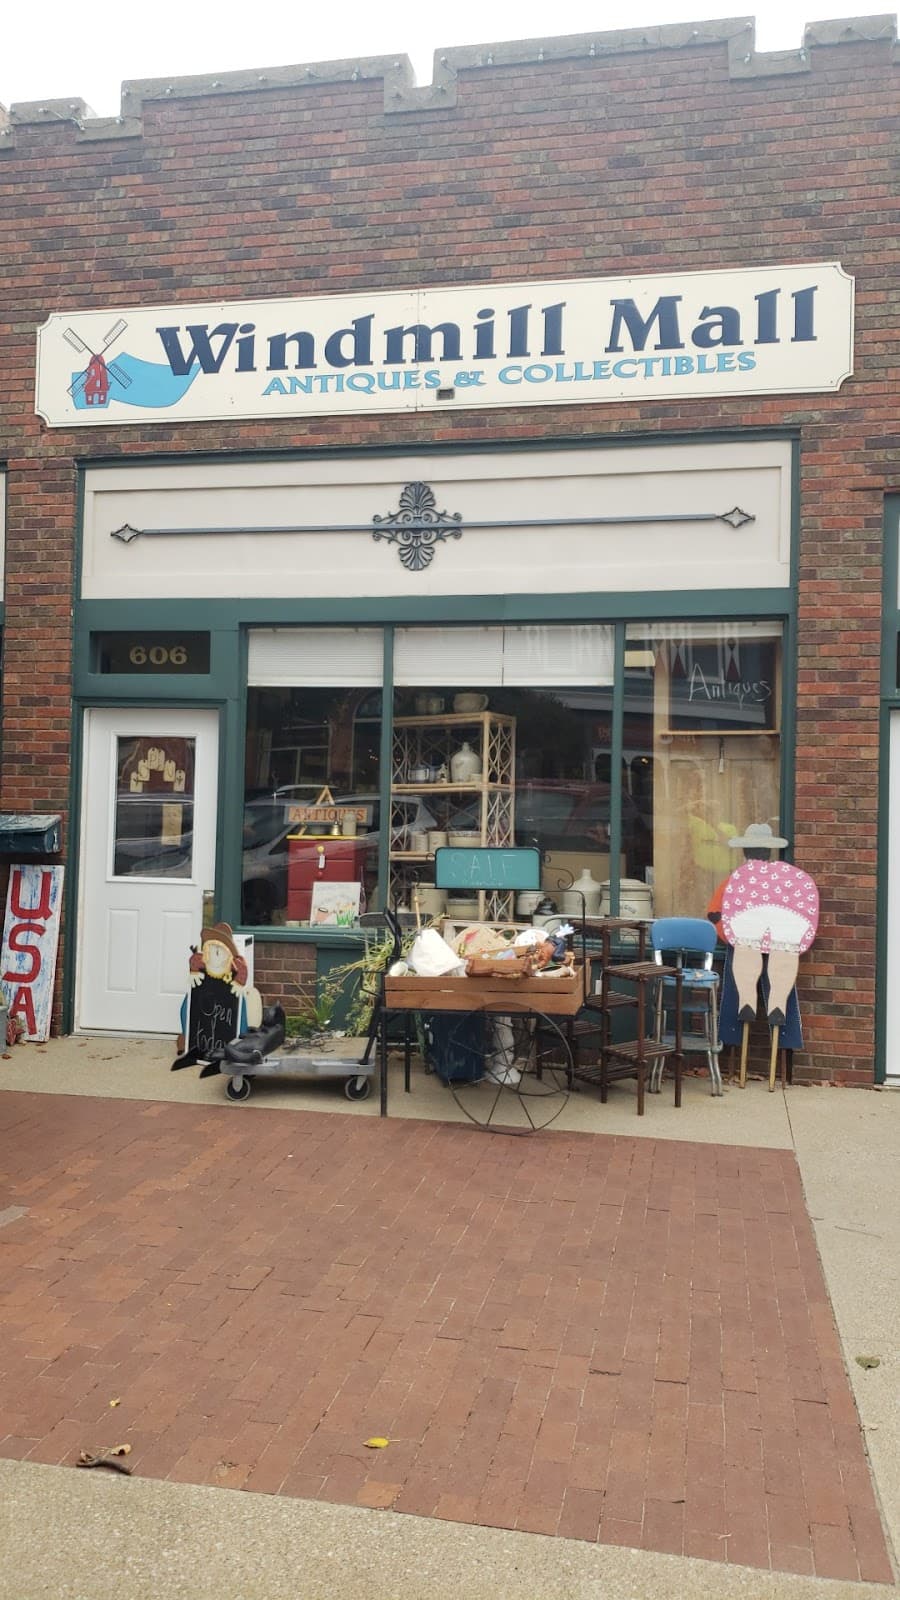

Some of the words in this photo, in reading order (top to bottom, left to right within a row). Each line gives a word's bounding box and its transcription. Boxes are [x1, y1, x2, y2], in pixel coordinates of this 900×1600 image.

[156, 302, 566, 376] Windmill
[604, 285, 818, 353] Mall
[262, 369, 441, 396] ANTIQUES
[453, 370, 485, 388] &
[498, 351, 756, 385] COLLECTIBLES
[129, 646, 188, 665] 606
[688, 663, 772, 710] Antiques
[2, 870, 53, 1036] USA
